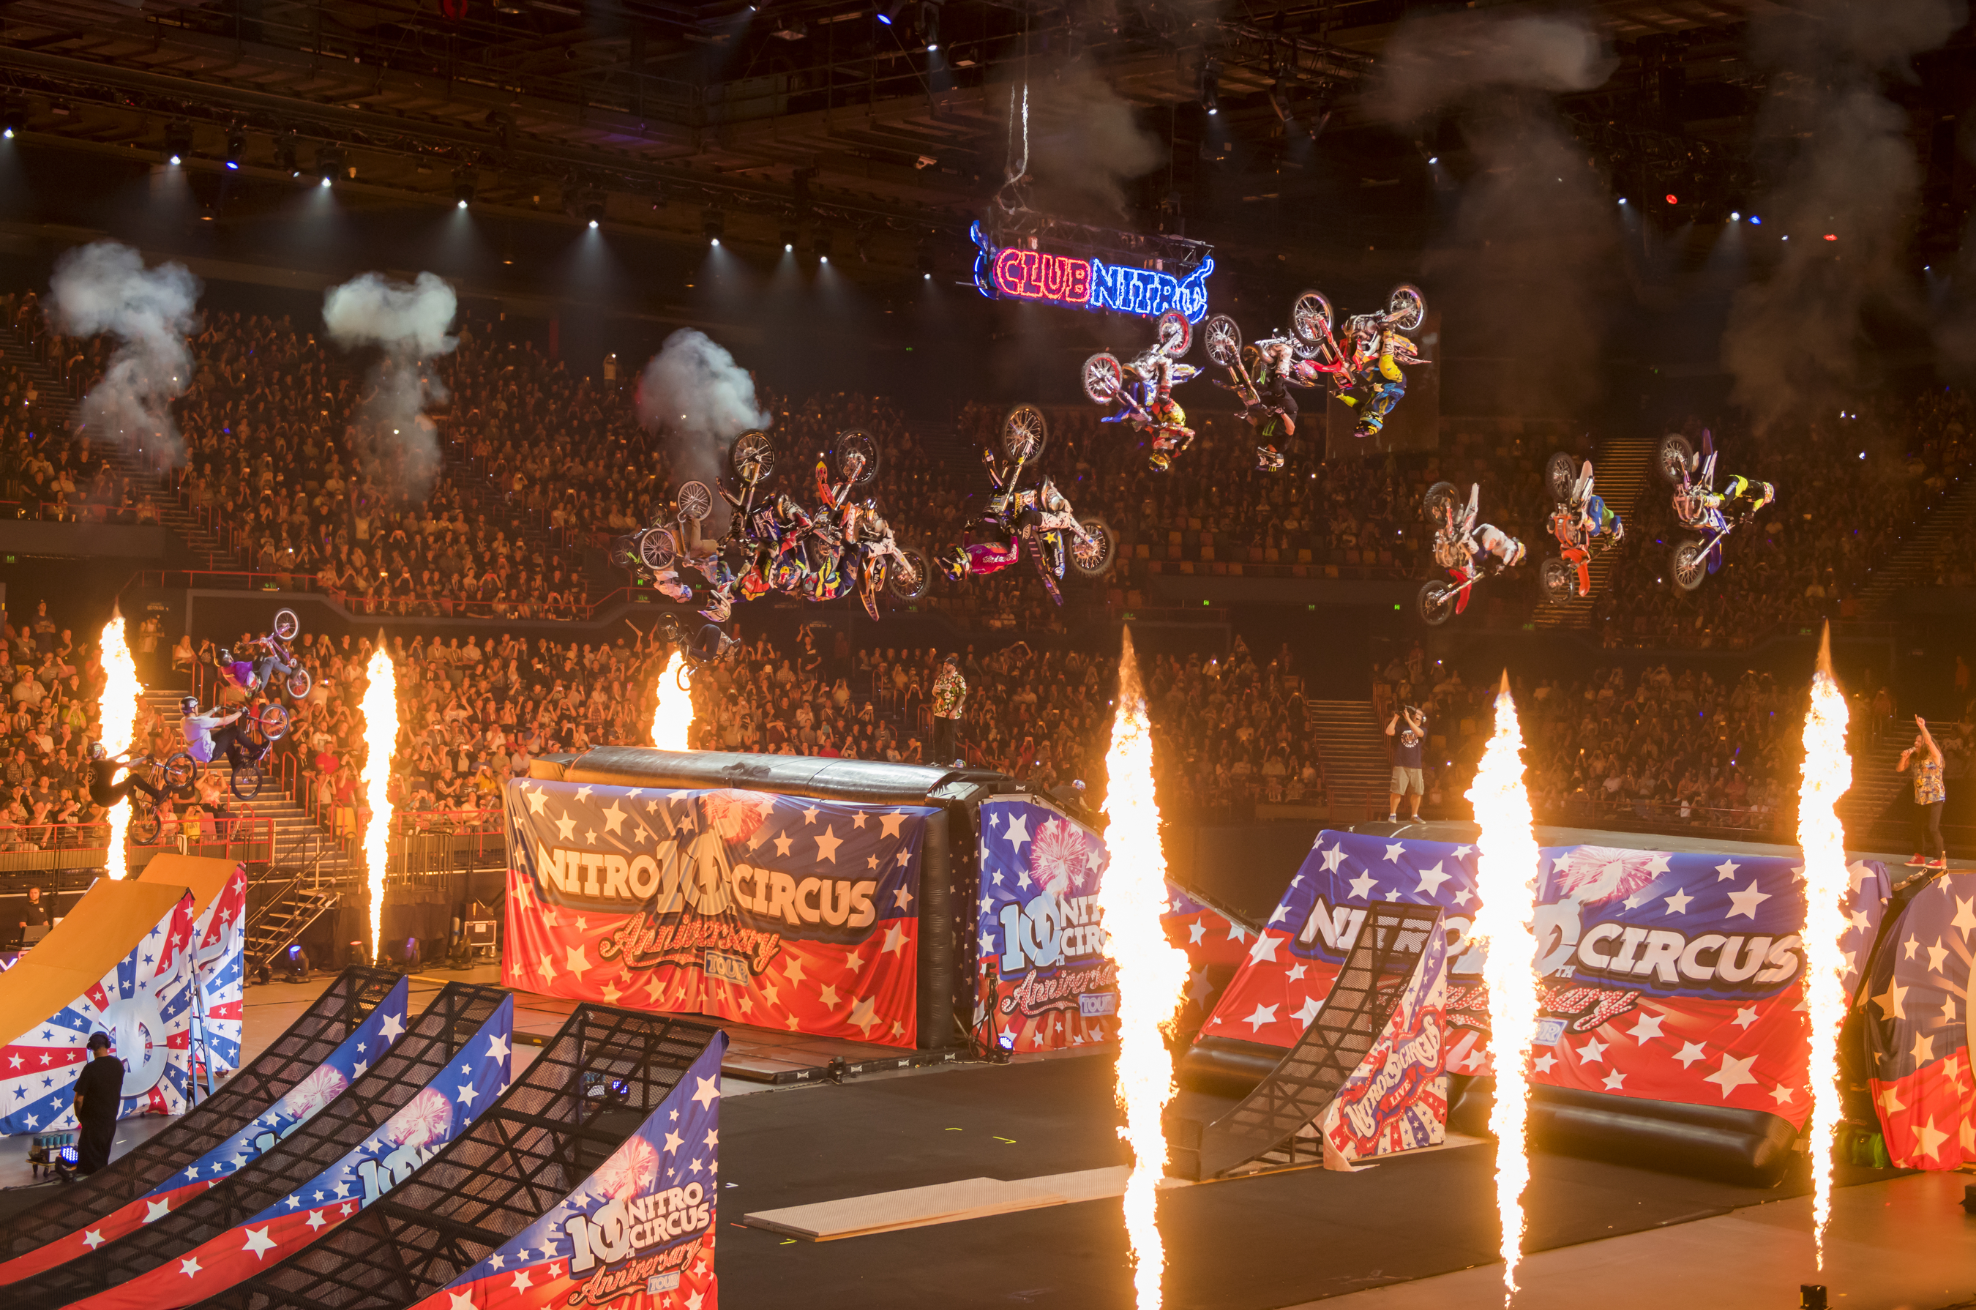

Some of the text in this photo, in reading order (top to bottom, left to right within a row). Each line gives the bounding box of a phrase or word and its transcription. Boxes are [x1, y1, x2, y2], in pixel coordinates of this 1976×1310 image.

[997, 247, 1214, 324] CLUB NITRO
[537, 841, 660, 898] NITRO
[731, 863, 877, 928] CIRCUS
[600, 911, 780, 973] Anniversary
[707, 954, 748, 980] TOUR
[1577, 922, 1803, 985] CIRCUS
[1344, 1015, 1441, 1139] NITRO CIRCUS
[1389, 1079, 1413, 1107] LIVE
[627, 1181, 704, 1227] NITRO
[629, 1202, 710, 1249] CIRCUS
[568, 1237, 703, 1305] Anniversary
[649, 1273, 680, 1292] TOUR
